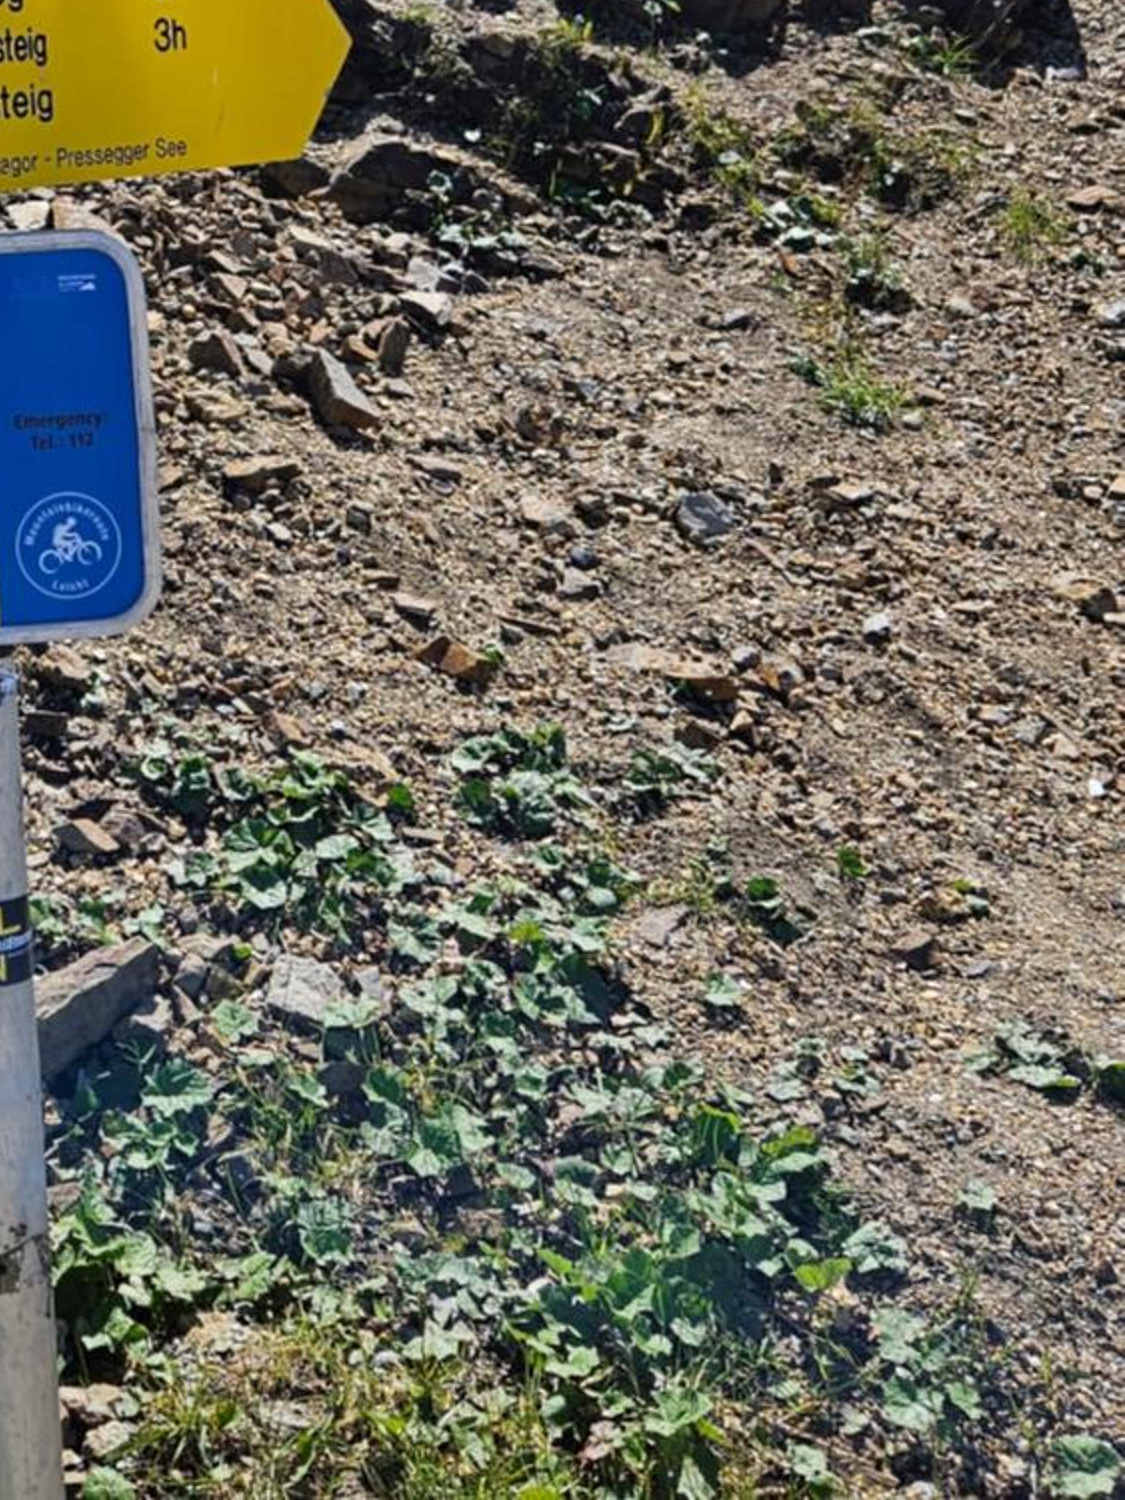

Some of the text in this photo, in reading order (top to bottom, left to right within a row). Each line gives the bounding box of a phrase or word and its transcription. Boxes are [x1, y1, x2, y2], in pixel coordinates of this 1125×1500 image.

[154, 17, 187, 53] 3h
[55, 144, 150, 170] Pressegger
[154, 137, 188, 159] See
